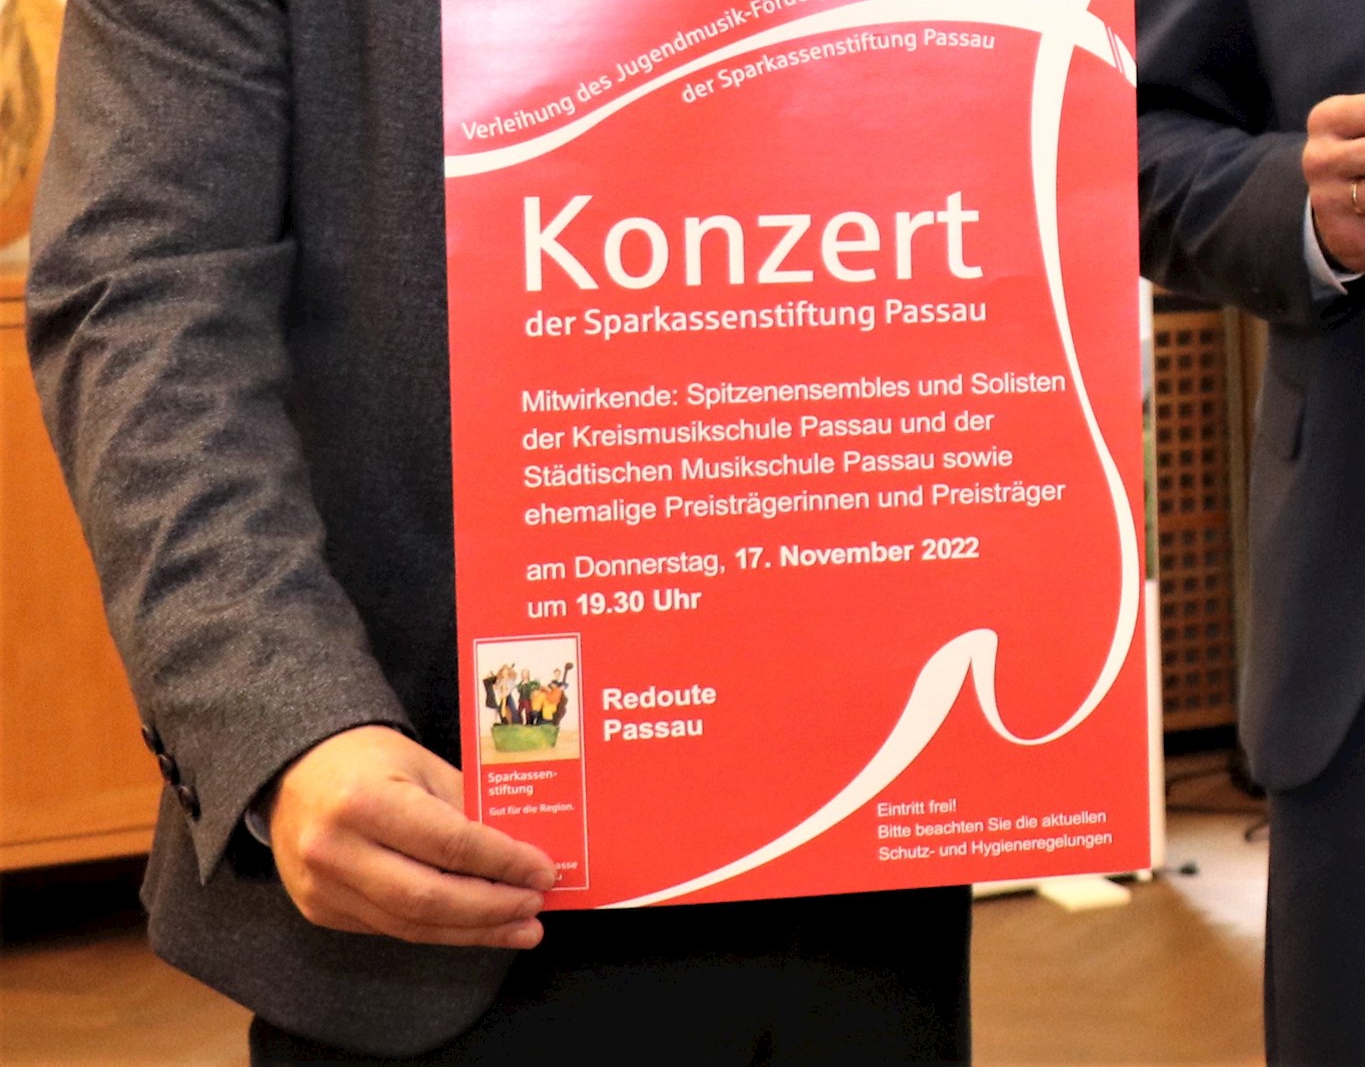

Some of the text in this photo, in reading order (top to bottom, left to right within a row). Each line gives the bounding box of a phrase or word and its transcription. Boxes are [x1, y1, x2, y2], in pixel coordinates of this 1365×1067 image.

[682, 28, 995, 103] der Sparkassenstiftung Passau
[462, 96, 576, 140] Verleihung
[576, 75, 612, 102] des
[524, 191, 983, 292] Konzert
[525, 299, 986, 341] der Sparkassenstiftung Passau
[522, 372, 1065, 412] Mitwirkende: Spitzenensembles und Solisten
[522, 410, 995, 451] der Kreismusikschule Passau und der
[524, 445, 1013, 488] Städtischen Musikschule Passau sowie
[525, 480, 1066, 526] ehemalige Preisträgerinnen und Preisträger
[527, 536, 979, 581] am Donnerstag, 17. November 2022
[528, 588, 702, 619] um 19.30 Uhr
[603, 684, 716, 711] Redoute
[603, 719, 703, 741] Passau
[488, 770, 557, 784] Sparkassen-
[488, 784, 534, 797] stiftung
[877, 798, 956, 817] Eintritt frei!
[878, 811, 1107, 839] Bitte beachten Sie die aktuellen
[879, 833, 1112, 861] Schutz- und Hygieneregelungen
